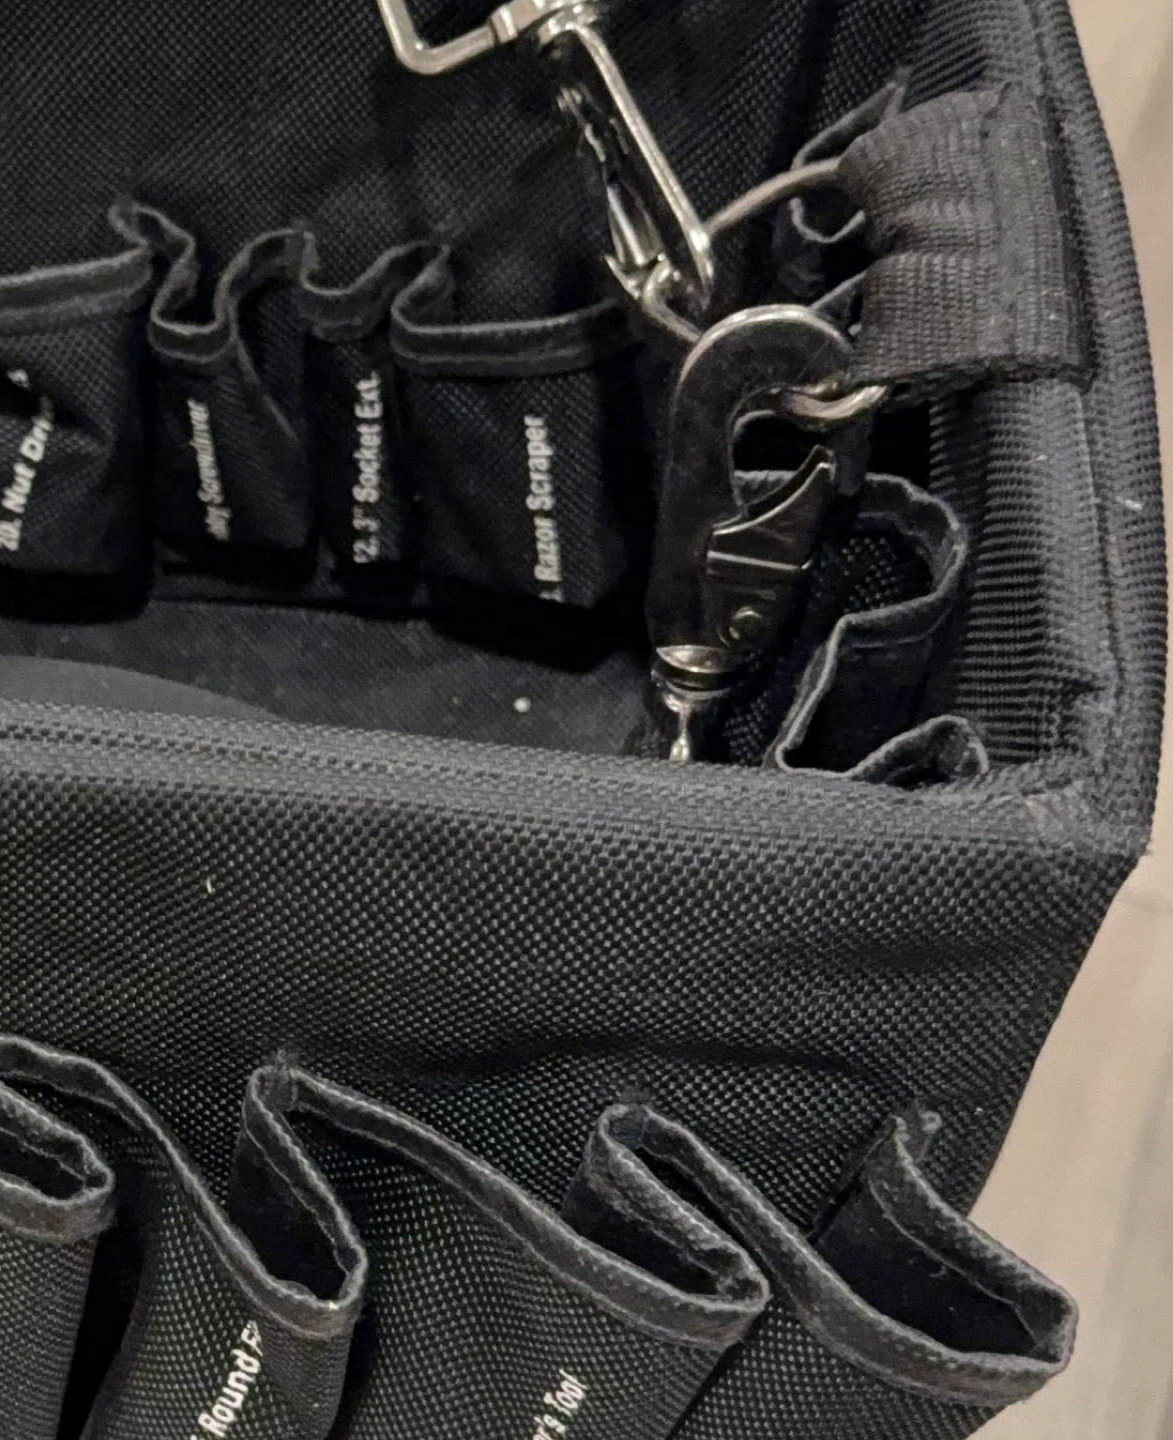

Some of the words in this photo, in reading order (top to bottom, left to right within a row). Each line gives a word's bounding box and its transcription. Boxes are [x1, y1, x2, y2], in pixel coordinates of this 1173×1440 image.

[1, 462, 37, 514] Nut
[352, 423, 382, 503] Socket
[524, 415, 556, 511] Scraper
[533, 517, 563, 582] Razor
[198, 1348, 261, 1437] Round
[543, 1368, 590, 1419] Tool
